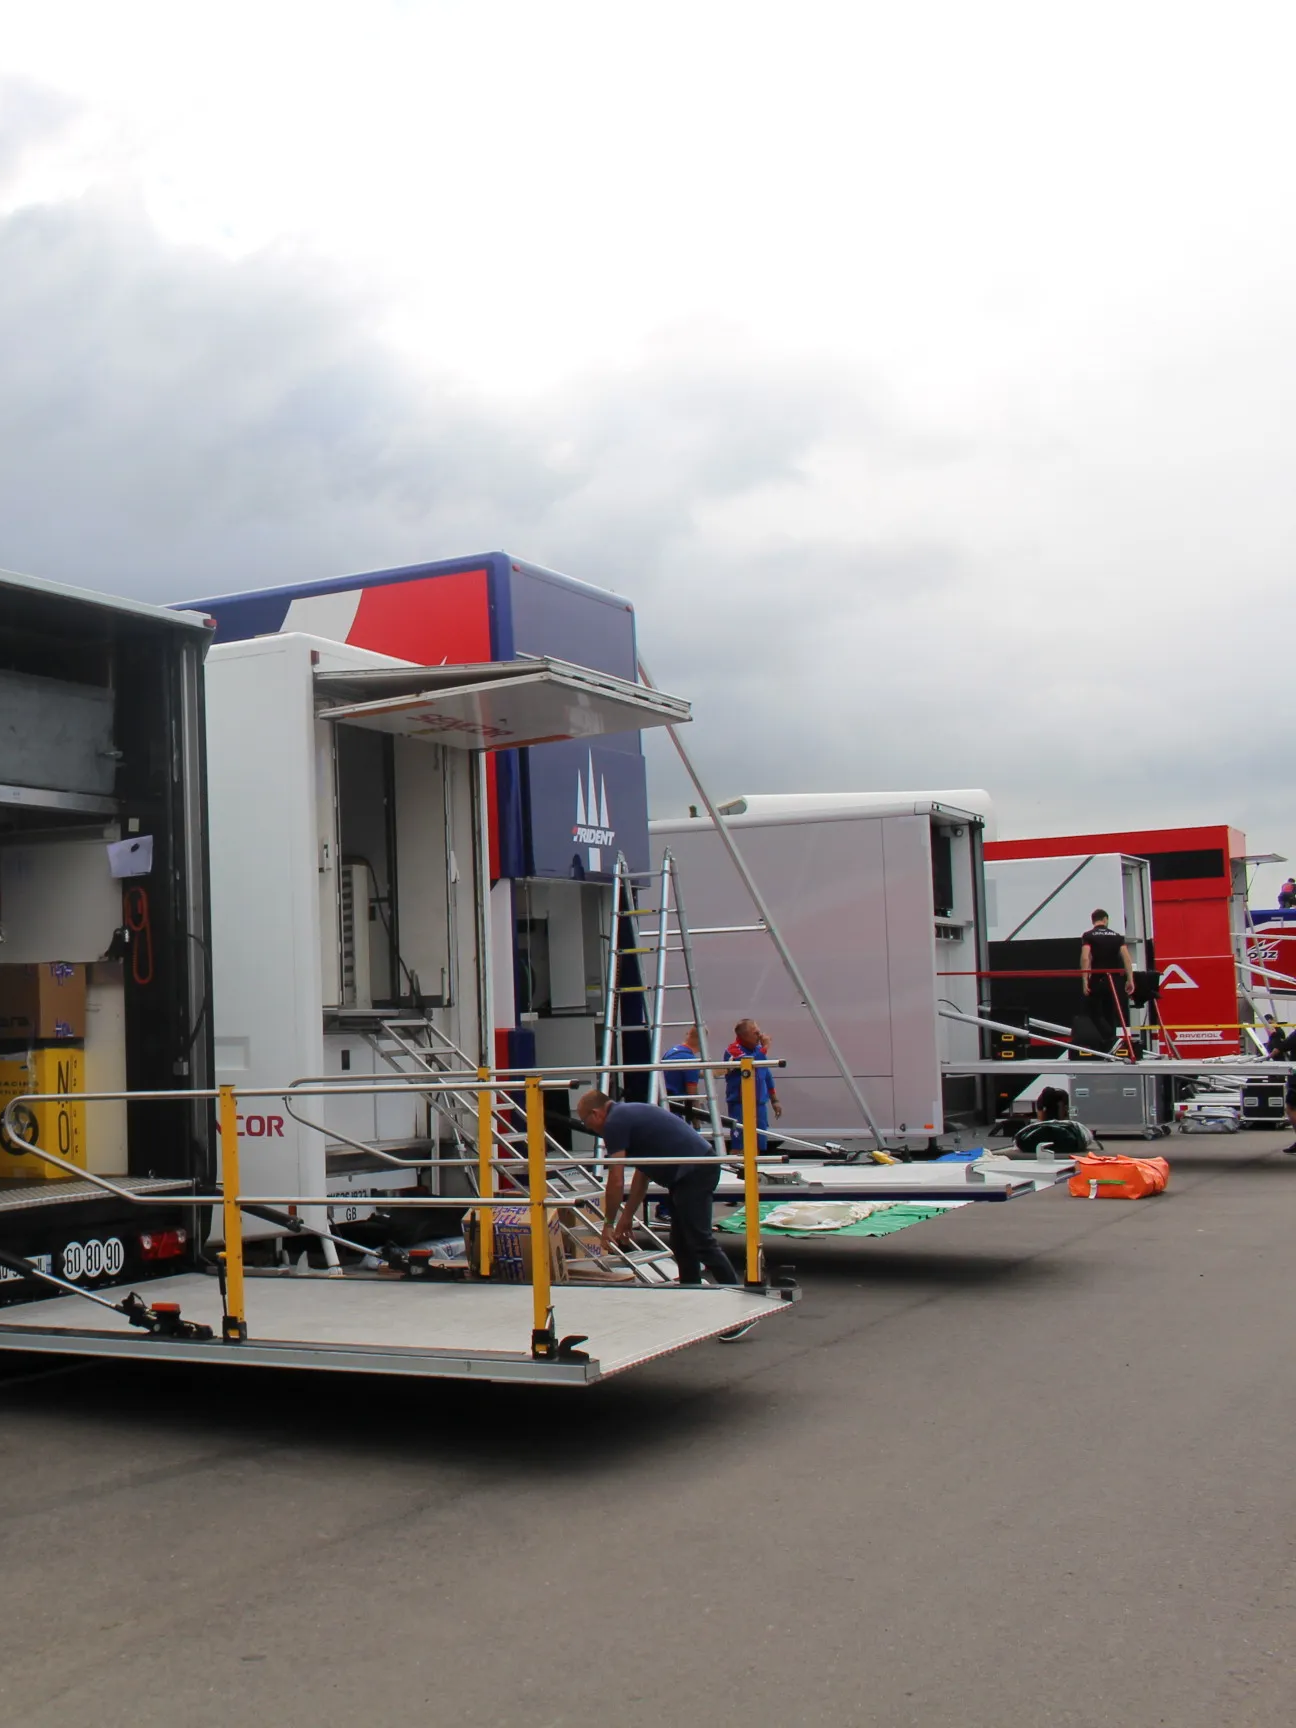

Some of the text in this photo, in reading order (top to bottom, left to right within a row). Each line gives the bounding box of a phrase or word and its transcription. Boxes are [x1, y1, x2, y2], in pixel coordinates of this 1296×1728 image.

[571, 826, 615, 846] TRIDENT
[345, 1207, 357, 1221] GB
[66, 1247, 81, 1275] 60
[85, 1243, 101, 1273] 80
[106, 1241, 120, 1270] 90
